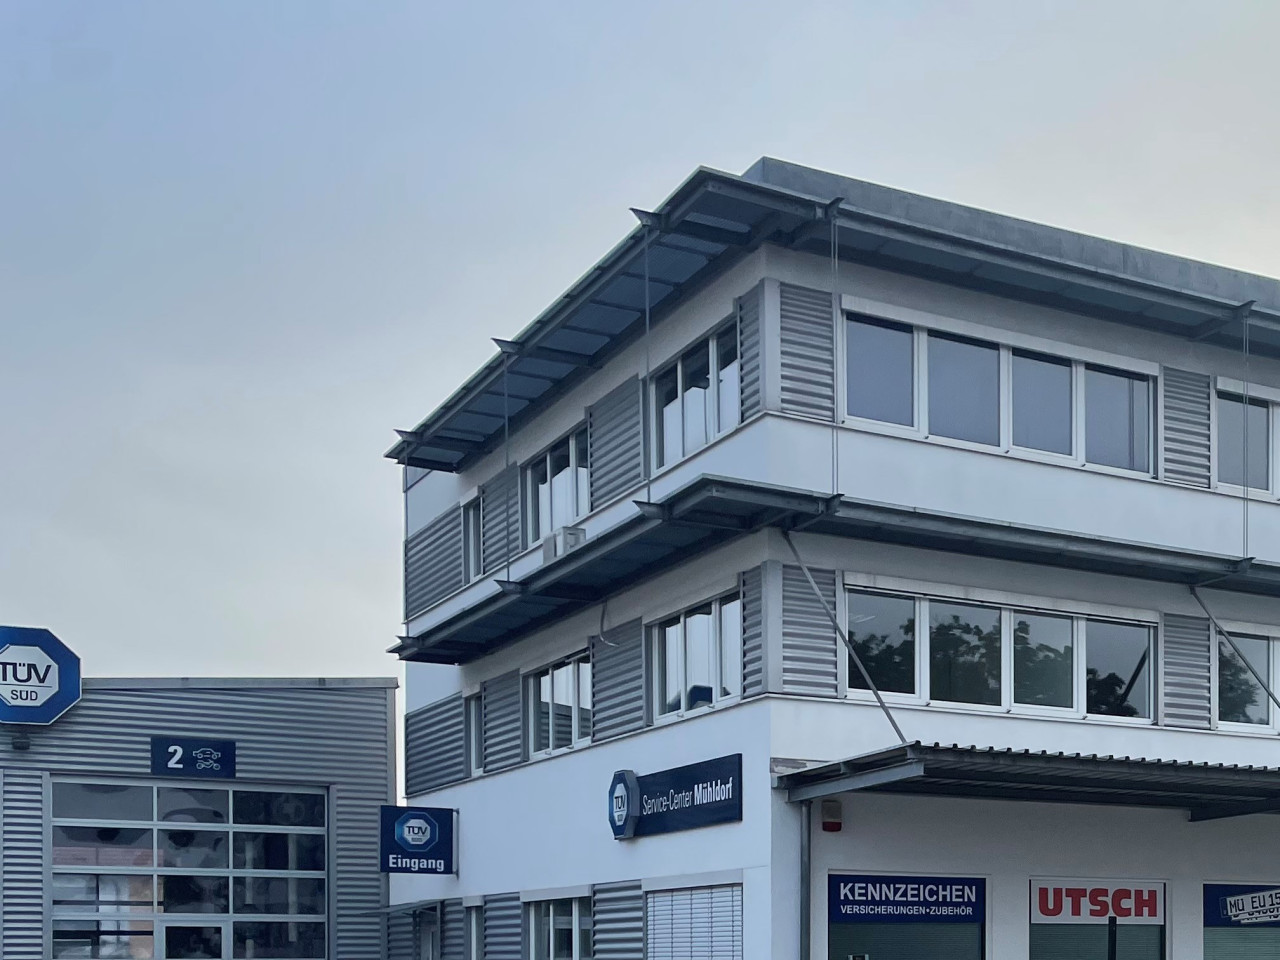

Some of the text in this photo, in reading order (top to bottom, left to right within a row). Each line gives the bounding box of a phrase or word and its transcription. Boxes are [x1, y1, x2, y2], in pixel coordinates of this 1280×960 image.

[0, 661, 52, 684] TÜV
[10, 689, 39, 701] SÜD
[167, 745, 184, 769] 2
[642, 776, 733, 815] Service-Center Mühldorf
[388, 854, 445, 872] Eingang
[839, 882, 977, 903] KENNZEICHEN
[1038, 887, 1158, 917] UTSCH
[1229, 898, 1245, 914] MÜ
[1250, 894, 1266, 910] EU
